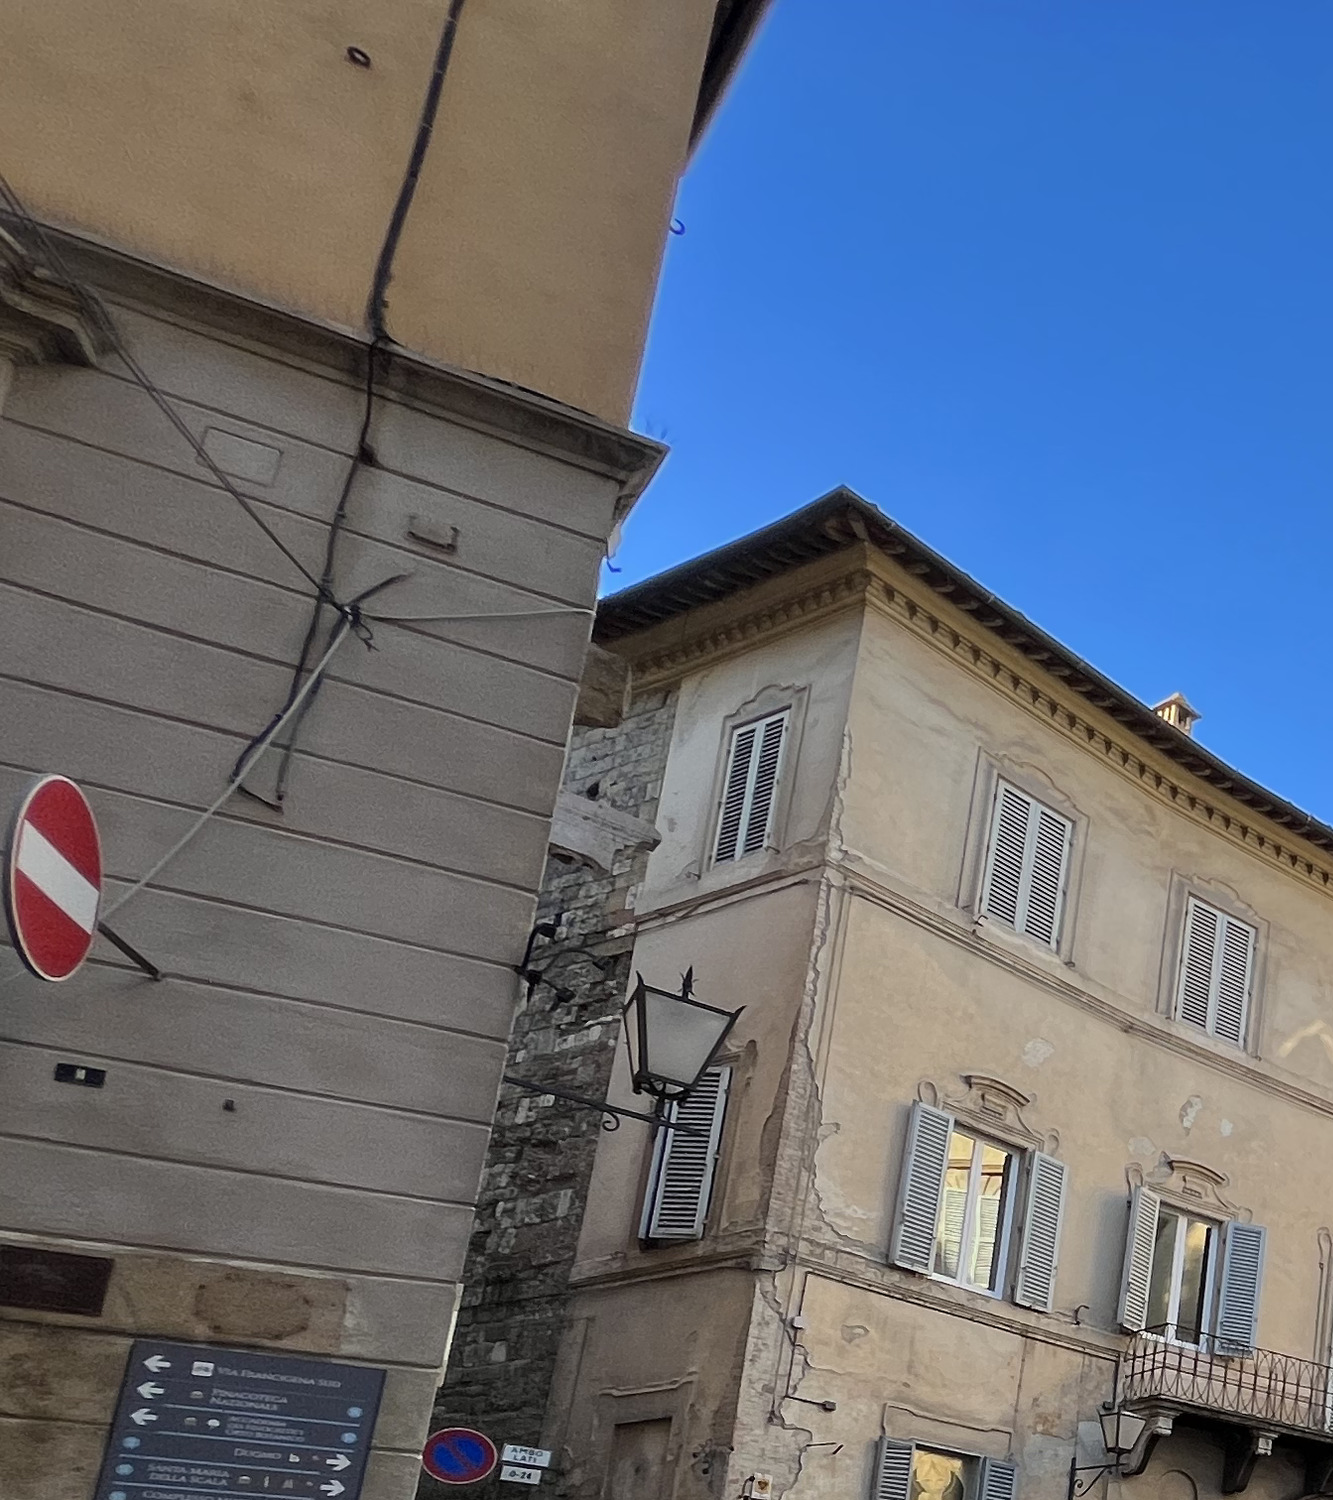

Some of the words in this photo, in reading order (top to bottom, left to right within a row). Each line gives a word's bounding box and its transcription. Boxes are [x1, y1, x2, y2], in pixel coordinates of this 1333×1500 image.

[211, 1388, 288, 1404] PINACOTECA
[234, 1448, 282, 1460] DUOMO
[511, 1447, 544, 1457] AMBO
[513, 1455, 537, 1463] LATI
[190, 1475, 228, 1486] SCALA
